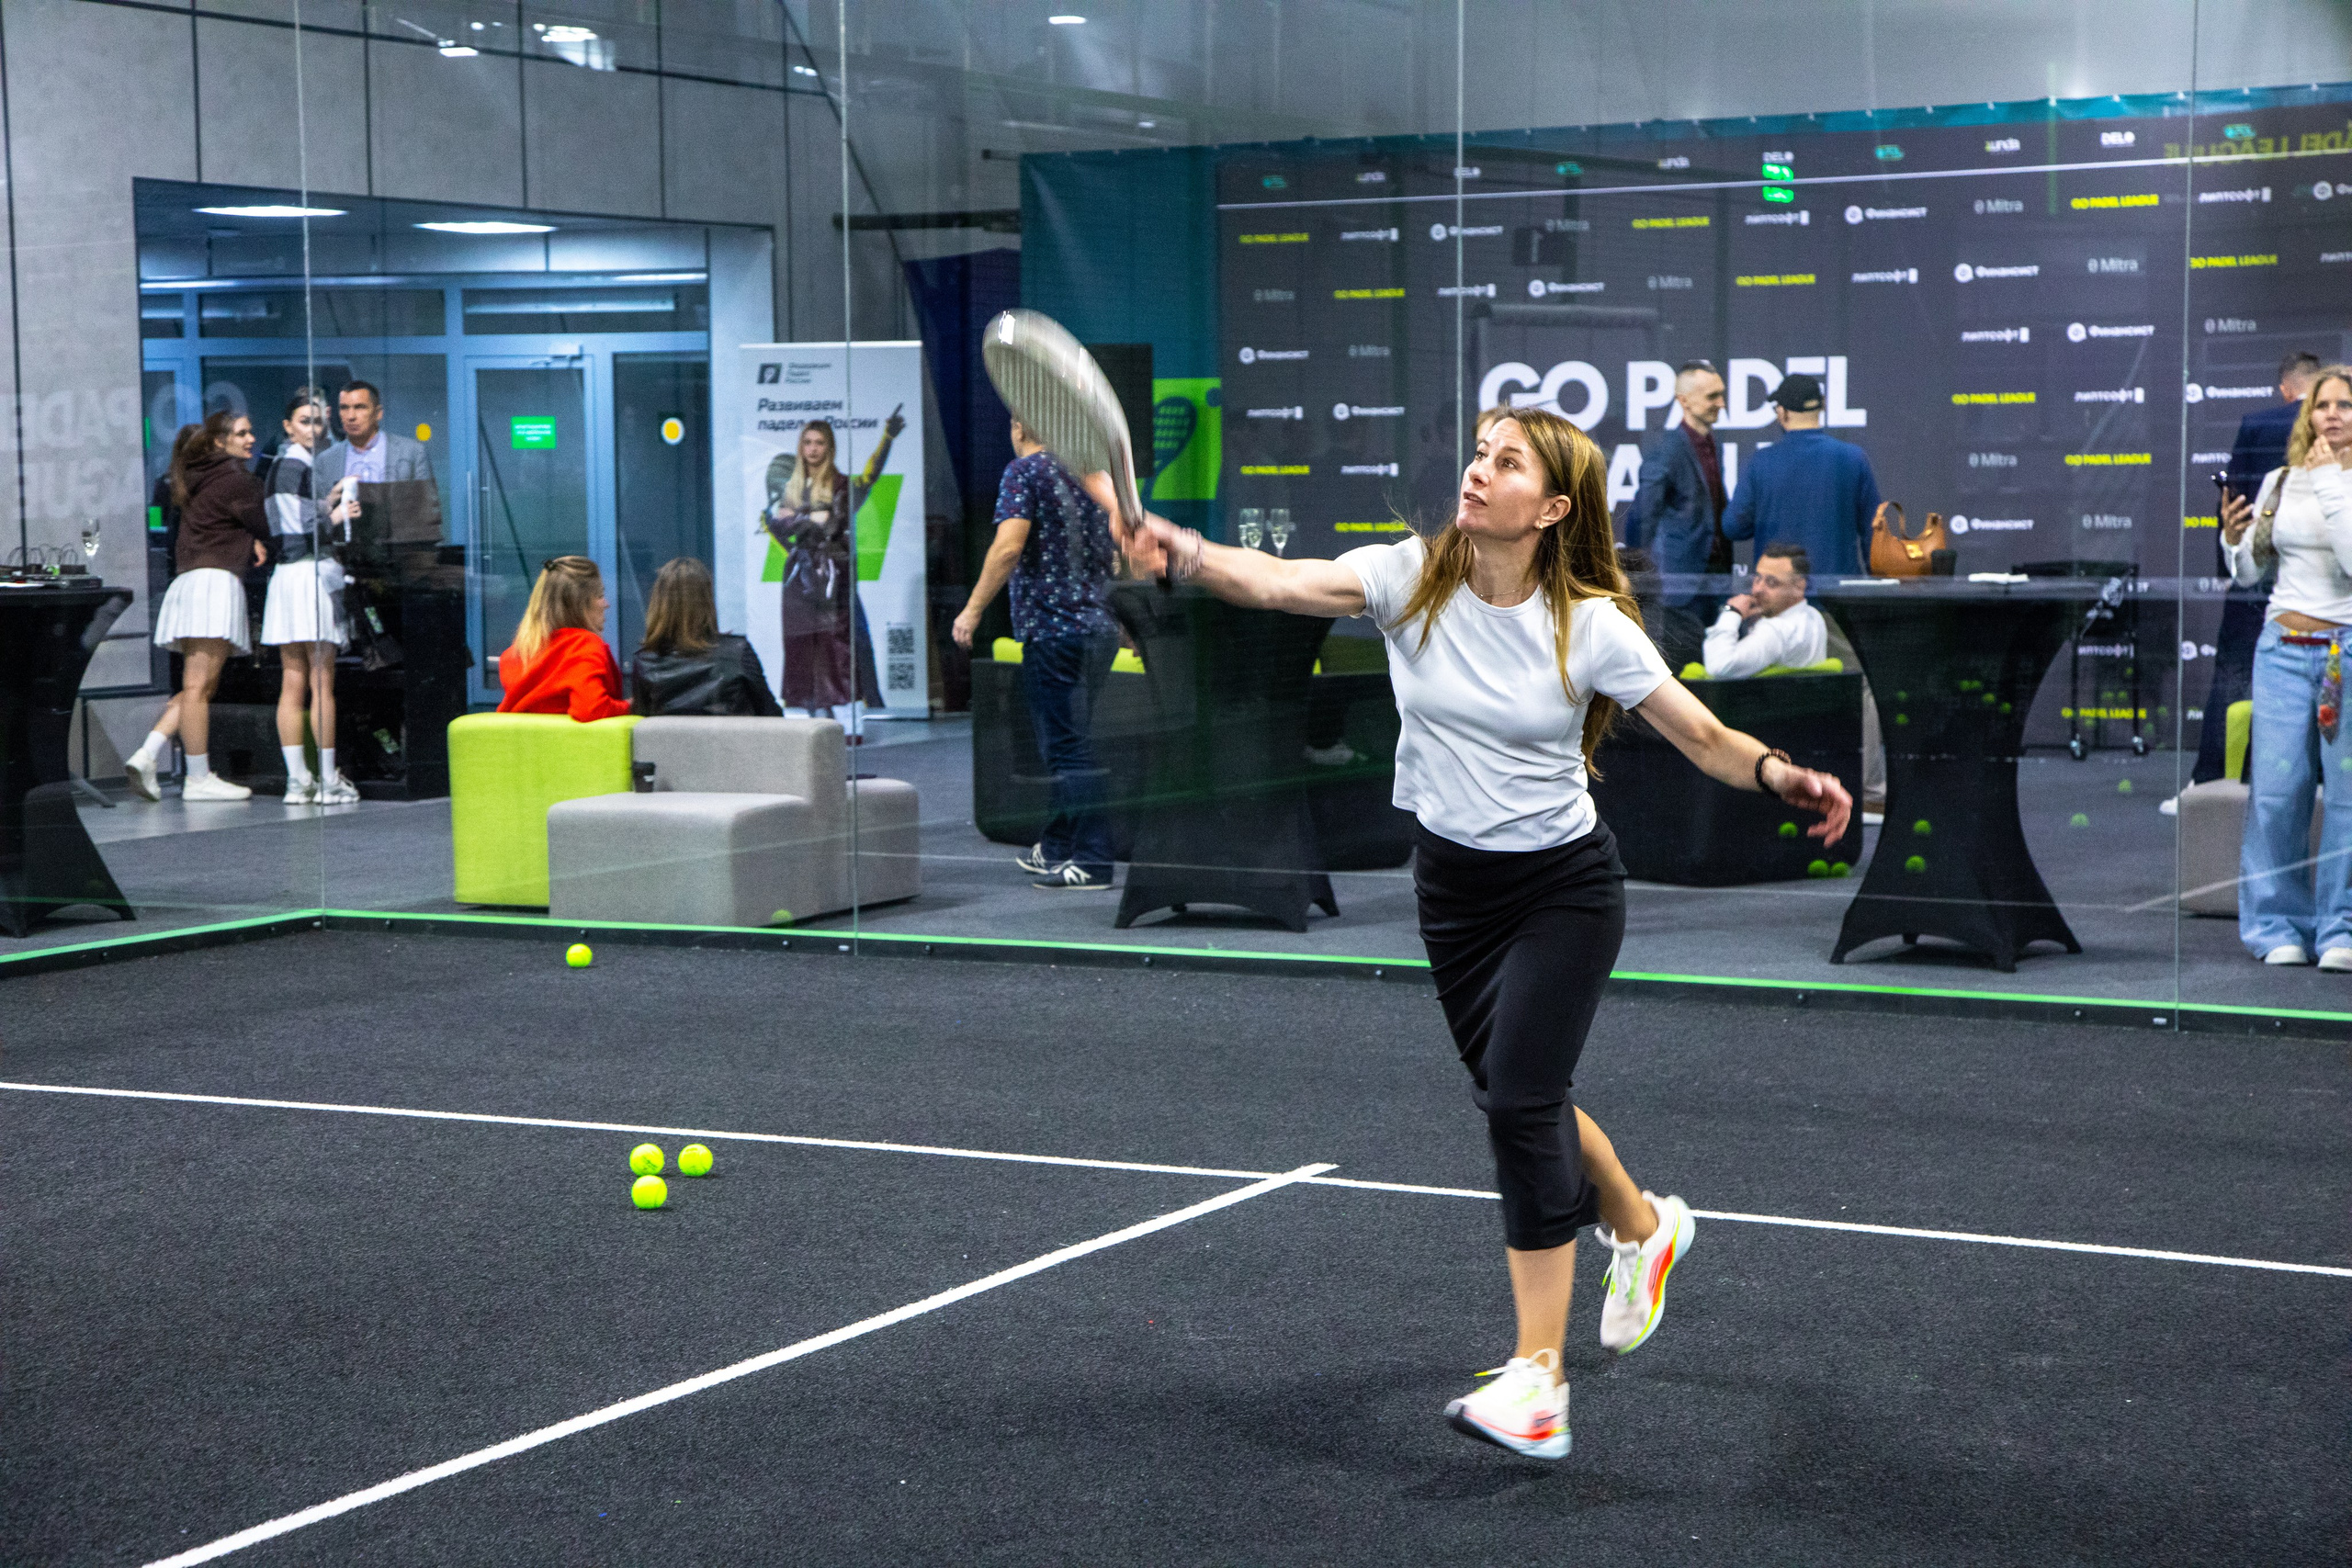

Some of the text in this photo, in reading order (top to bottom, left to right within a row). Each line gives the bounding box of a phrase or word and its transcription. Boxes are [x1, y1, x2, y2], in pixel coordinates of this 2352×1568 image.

[2218, 318, 2257, 333] Mitra
[1478, 361, 1609, 432] GO
[758, 398, 842, 412] Развиваем
[825, 415, 878, 429] России
[1982, 453, 2018, 468] Mitra
[2095, 514, 2133, 529] Mitra
